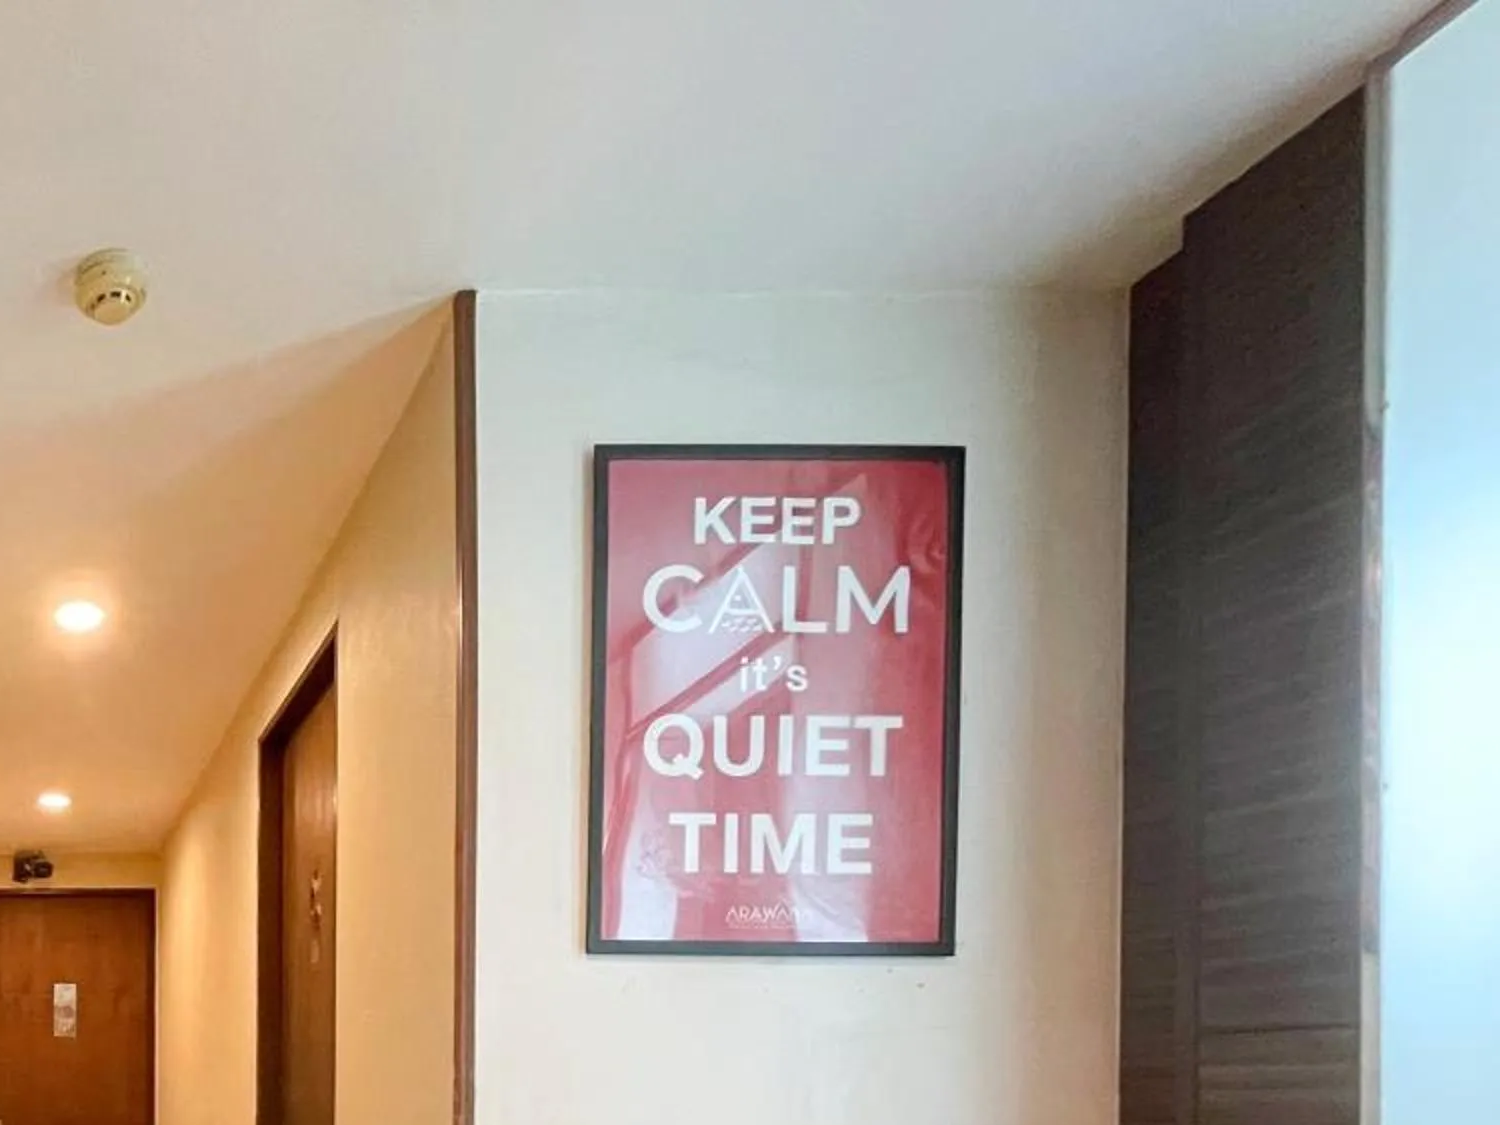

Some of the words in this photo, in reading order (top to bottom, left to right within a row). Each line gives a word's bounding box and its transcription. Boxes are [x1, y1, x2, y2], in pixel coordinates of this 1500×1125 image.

[693, 496, 861, 545] KEEP
[642, 564, 912, 634] CALM
[740, 656, 808, 692] it's
[642, 714, 904, 779] QUIET
[668, 812, 873, 875] TIME
[725, 900, 812, 923] ARAWA
